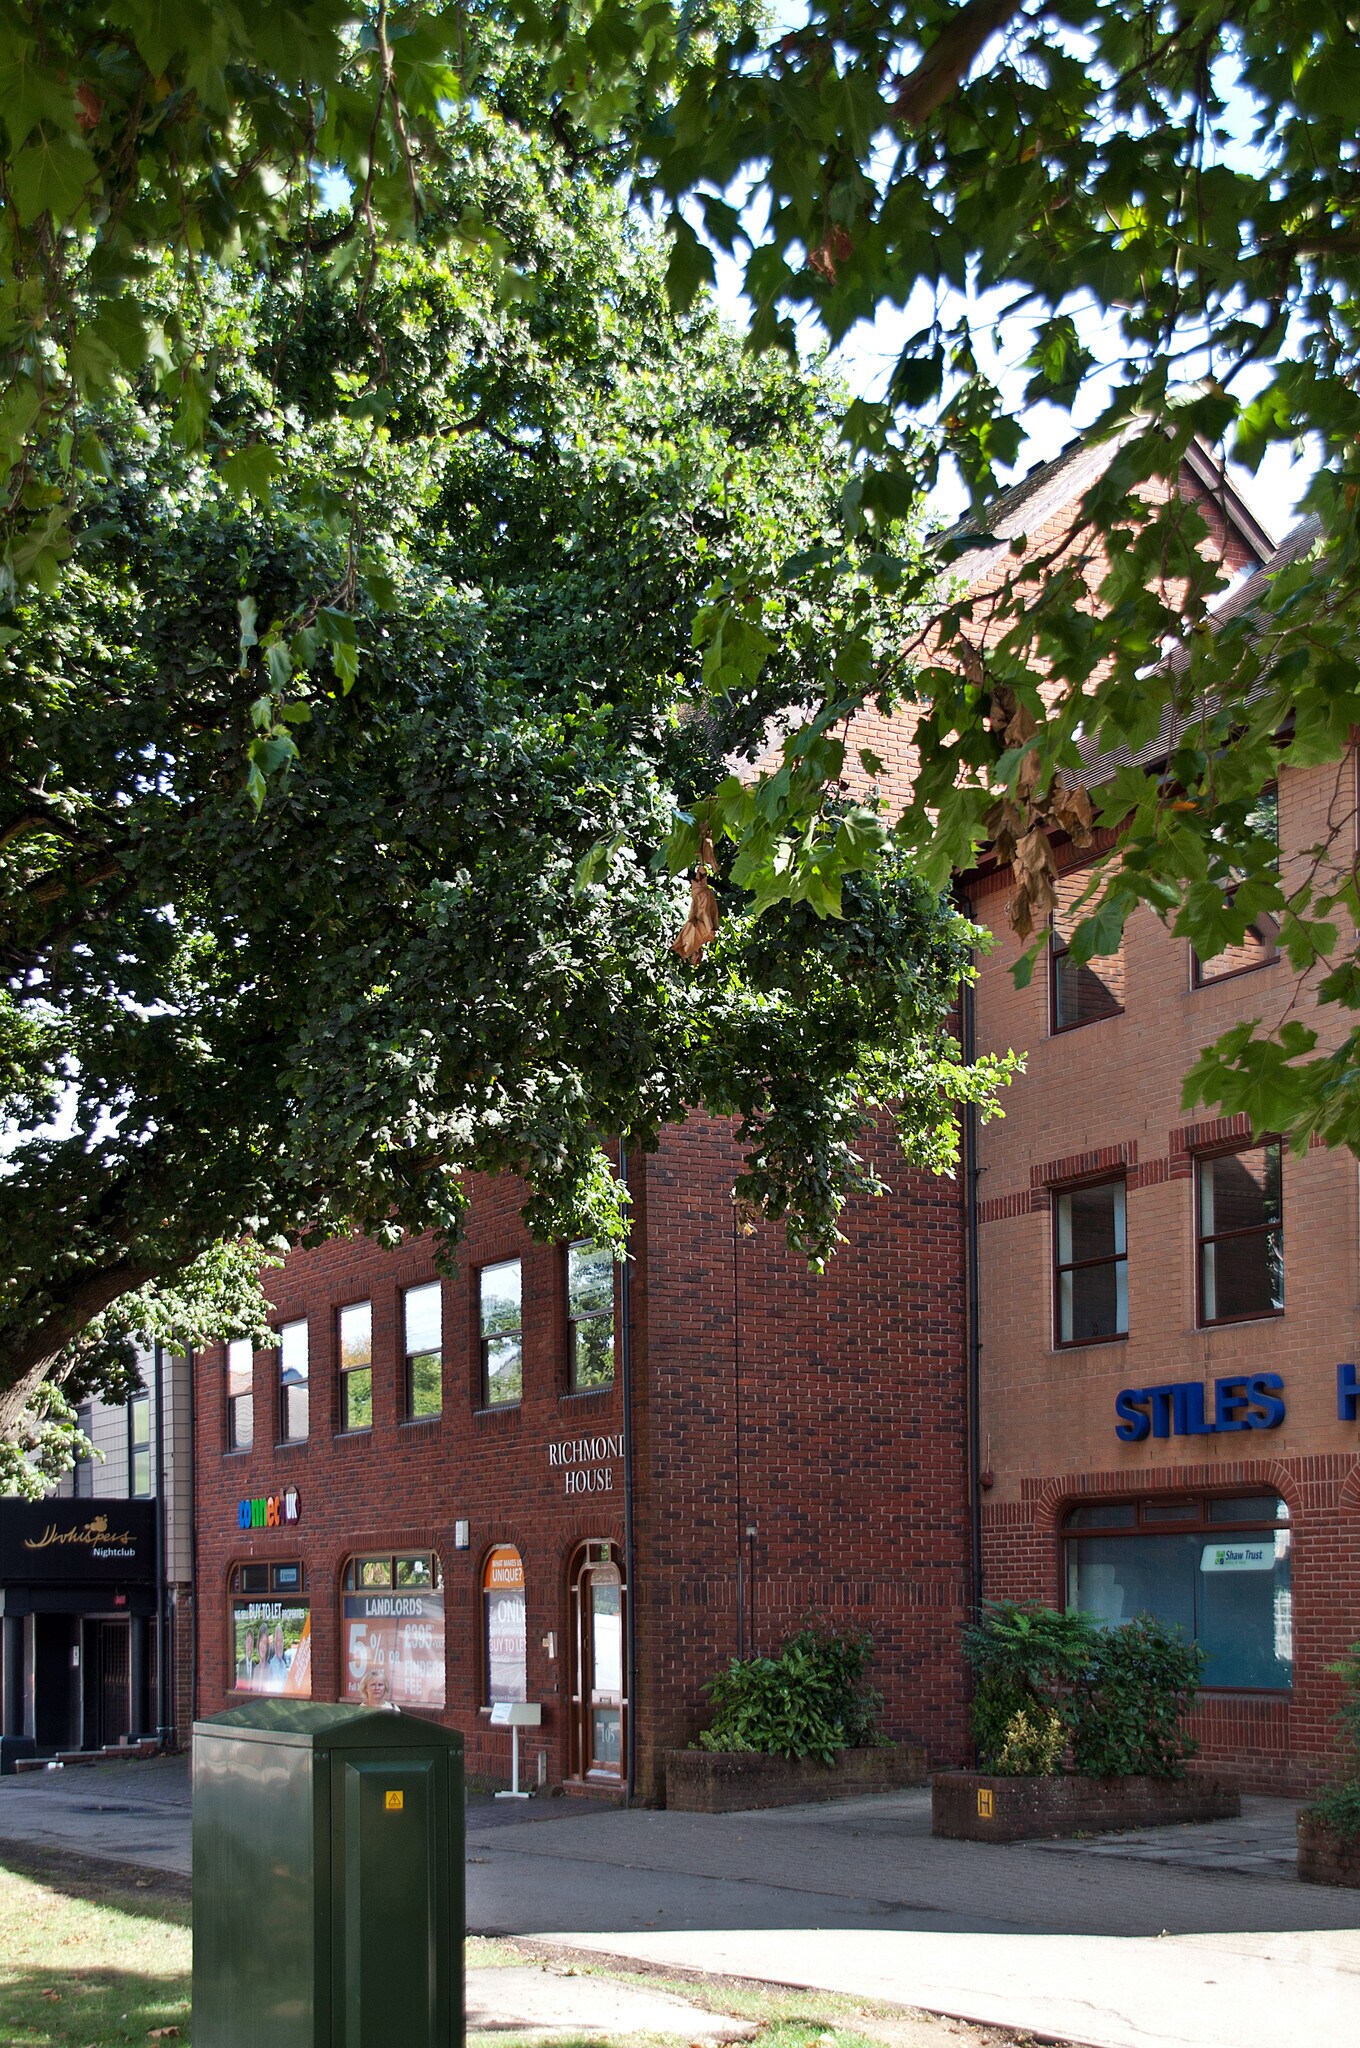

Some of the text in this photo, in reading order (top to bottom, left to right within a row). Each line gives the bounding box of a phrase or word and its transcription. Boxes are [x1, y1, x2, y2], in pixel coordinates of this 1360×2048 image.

[1115, 1373, 1286, 1442] STILES
[565, 1468, 612, 1493] HOUSE
[93, 1547, 136, 1557] Nightclub
[1226, 1549, 1263, 1560] Shaw Trust
[492, 1568, 522, 1583] UNIQUE?
[249, 1603, 261, 1619] BUY
[262, 1603, 270, 1620] TO
[272, 1603, 282, 1619] LET
[365, 1598, 422, 1616] LANDLORDS
[504, 1638, 514, 1652] TO
[601, 1728, 615, 1743] 105
